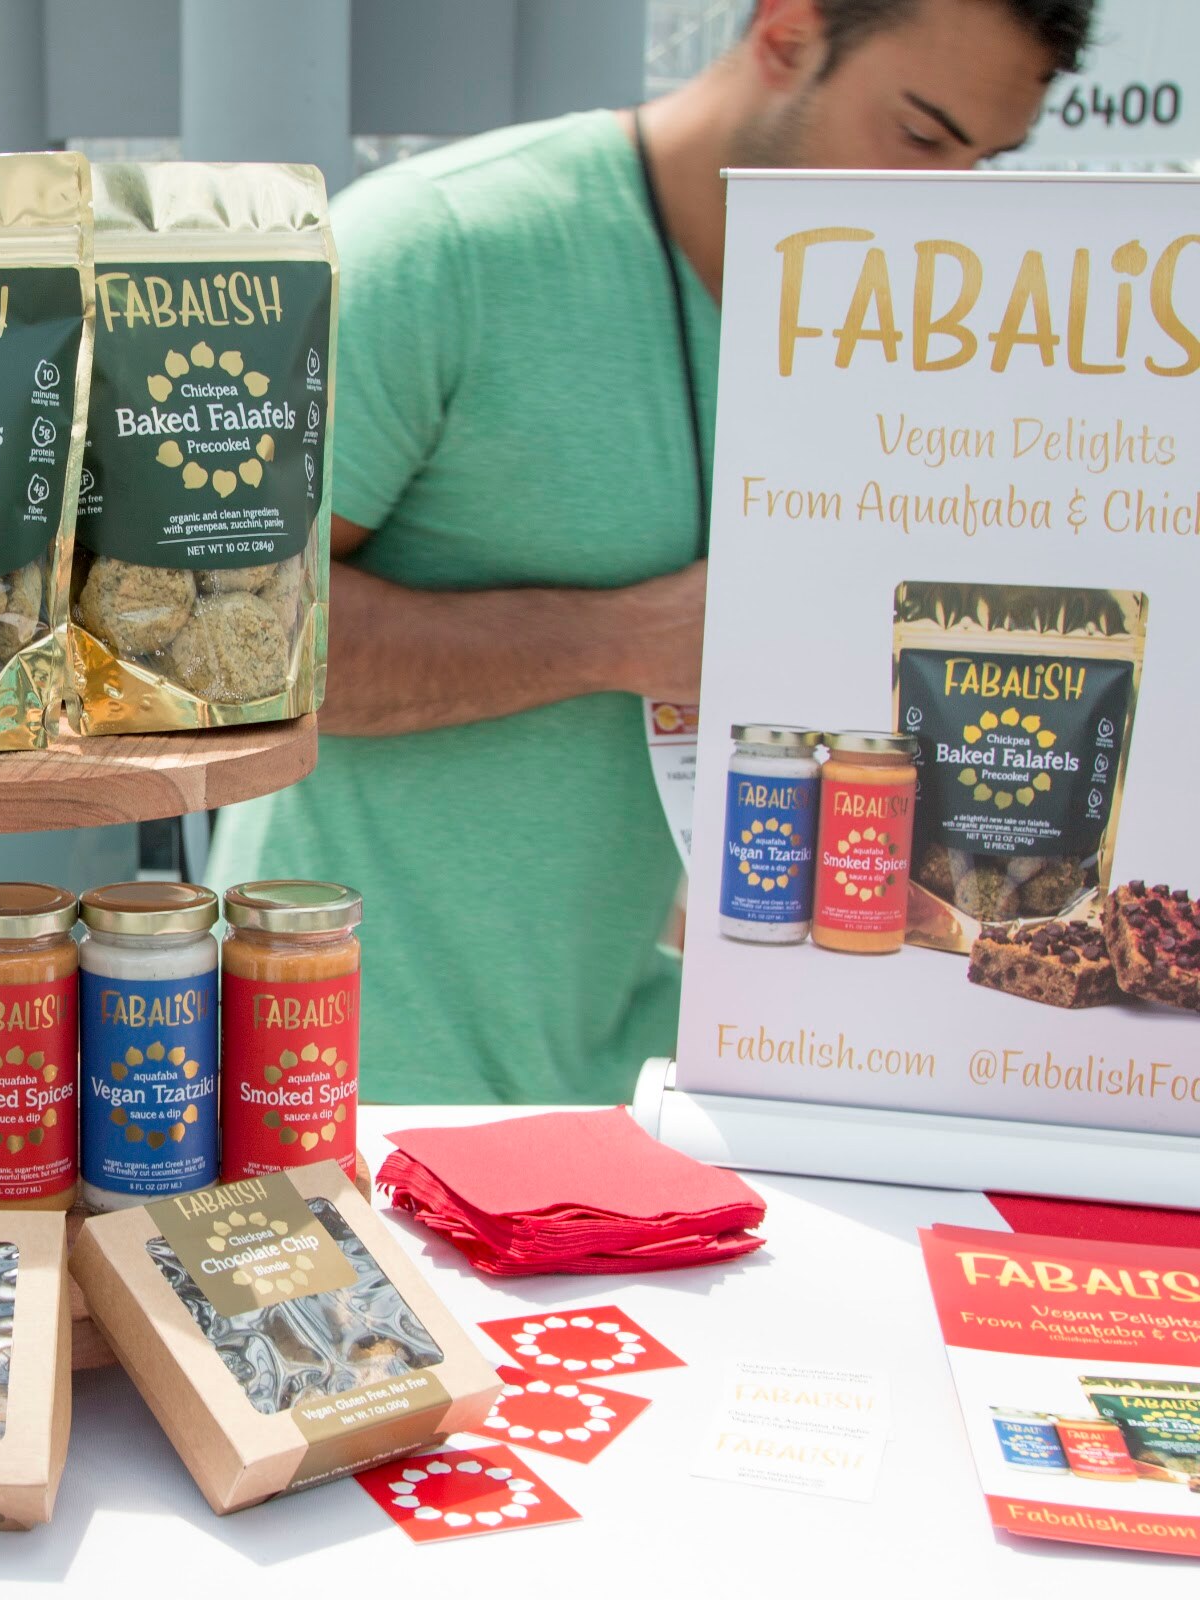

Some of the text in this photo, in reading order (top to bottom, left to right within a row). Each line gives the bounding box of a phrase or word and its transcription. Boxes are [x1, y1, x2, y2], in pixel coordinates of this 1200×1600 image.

[42, 369, 54, 381] 10
[32, 390, 60, 400] minutes
[181, 383, 238, 399] Chickpea
[115, 401, 296, 438] Baked Falafels
[38, 426, 51, 440] 5g
[187, 438, 250, 454] Precooked
[876, 413, 1176, 473] Vegan Delights
[31, 448, 55, 458] protein
[33, 483, 45, 496] 4g
[28, 505, 44, 514] fiber
[741, 476, 1200, 537] From Aquafaba & Chic
[987, 733, 1030, 747] Chickpea
[936, 743, 1079, 772] Baked Falafels
[981, 769, 1029, 782] Precooked
[729, 841, 763, 860] Vegan
[823, 851, 907, 873] Smoked Spices
[716, 1023, 935, 1078] Fabalish.com
[133, 1071, 178, 1082] aquafaba
[287, 1072, 331, 1084] aquafaba
[25, 1081, 74, 1111] Spices
[91, 1076, 214, 1106] Vegan Tzatziki
[240, 1078, 358, 1107] Smoked Spices
[129, 1110, 156, 1119] sauce
[166, 1108, 181, 1121] dip
[228, 1229, 275, 1248] Chickpea
[200, 1234, 319, 1276] Chocolate Chip
[253, 1260, 290, 1277] Blondie
[1031, 1304, 1104, 1322] Vegan
[960, 1311, 1023, 1329] From
[1030, 1319, 1145, 1339] Aquafaba
[1152, 1327, 1166, 1341] &
[1007, 1503, 1196, 1539] Fabalish.com
